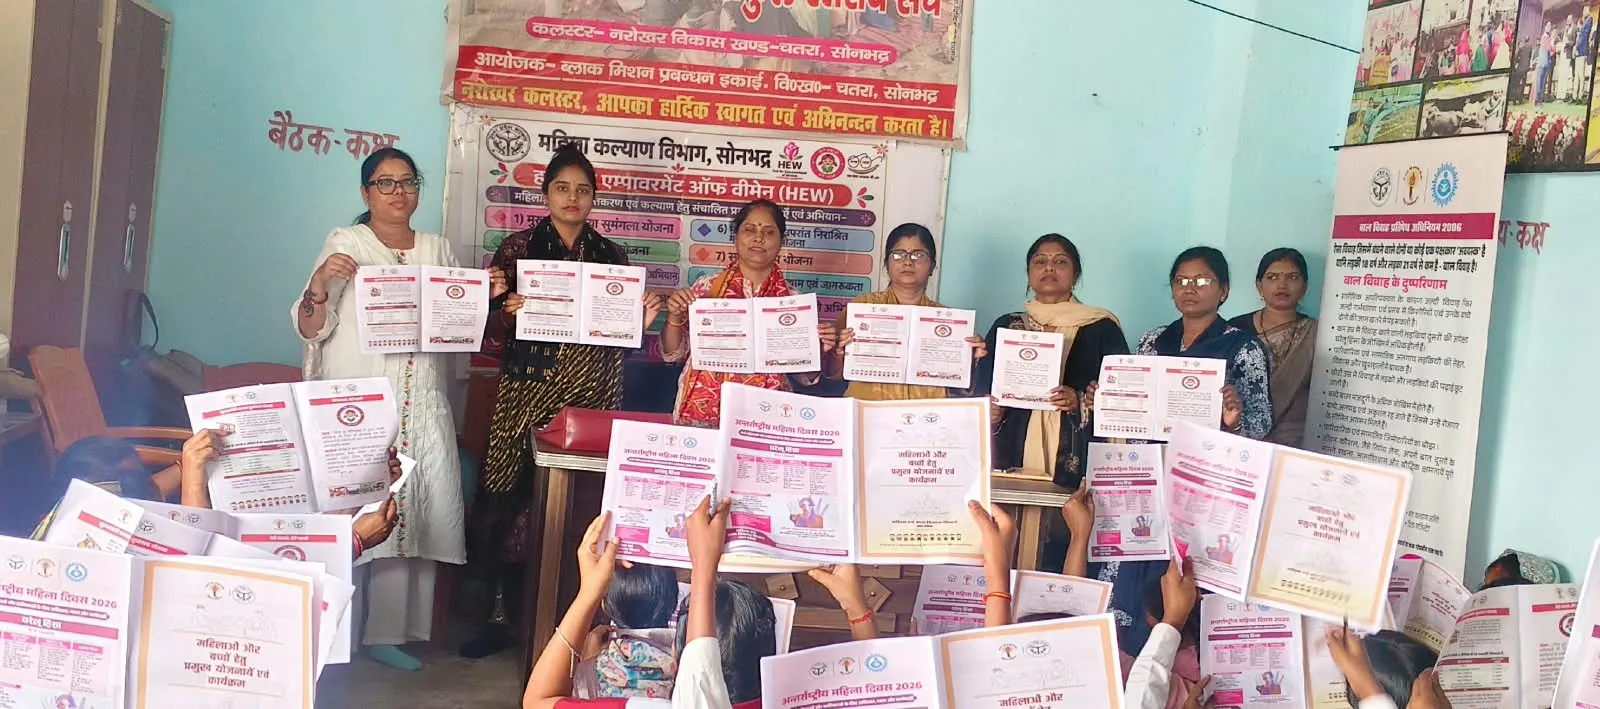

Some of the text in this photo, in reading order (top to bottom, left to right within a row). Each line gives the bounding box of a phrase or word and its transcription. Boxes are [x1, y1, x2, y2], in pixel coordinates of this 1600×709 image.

[609, 27, 667, 44] नरोखर
[671, 29, 725, 48] विकास
[831, 44, 890, 63] सोनभद्र
[561, 60, 604, 76] ब्लाक
[609, 60, 654, 80] मिशन
[659, 68, 714, 85] प्रबन्धन
[836, 83, 878, 99] चतरा,
[883, 83, 939, 104] सोनभद्र
[461, 79, 947, 137] नरोखर कलस्टर, आपका हार्दिक स्वागत एवं अभिनन्दन करता है।
[593, 138, 655, 160] कल्याण
[658, 136, 711, 165] विभाग,
[716, 141, 773, 169] सोनभद्र
[778, 160, 802, 170] HEW
[601, 173, 684, 194] एम्पावरमेंट
[688, 177, 727, 197] ऑफ
[731, 179, 774, 200] वीमेन
[779, 186, 834, 204] (HEW)
[625, 198, 640, 209] एवं
[640, 201, 675, 212] कल्याण
[675, 200, 690, 214] हेतु
[692, 202, 728, 215] संचालित
[513, 214, 524, 225] 1)
[791, 210, 804, 220] एवं
[601, 215, 675, 233] सुमंगला योजना
[717, 223, 728, 234] 6)
[813, 227, 849, 241] निराश्रित
[715, 252, 726, 263] 7)
[783, 253, 813, 267] योजना
[1362, 259, 1369, 268] 18
[1403, 261, 1409, 269] 21
[806, 277, 819, 289] एवं
[1363, 273, 1390, 289] विवाह
[1391, 274, 1400, 287] के
[1402, 275, 1448, 293] दुष्परिणाम
[26, 587, 57, 601] महिला
[60, 590, 88, 605] दिवस
[91, 597, 118, 609] 2026
[243, 642, 261, 654] और
[234, 653, 248, 667] हेतु
[184, 661, 211, 674] प्रमुख
[257, 668, 270, 679] एवं
[208, 675, 246, 688] कार्यक्रम
[831, 687, 862, 697] महिला
[865, 684, 892, 694] दिवस
[896, 681, 923, 690] 2026
[1045, 692, 1063, 703] और
